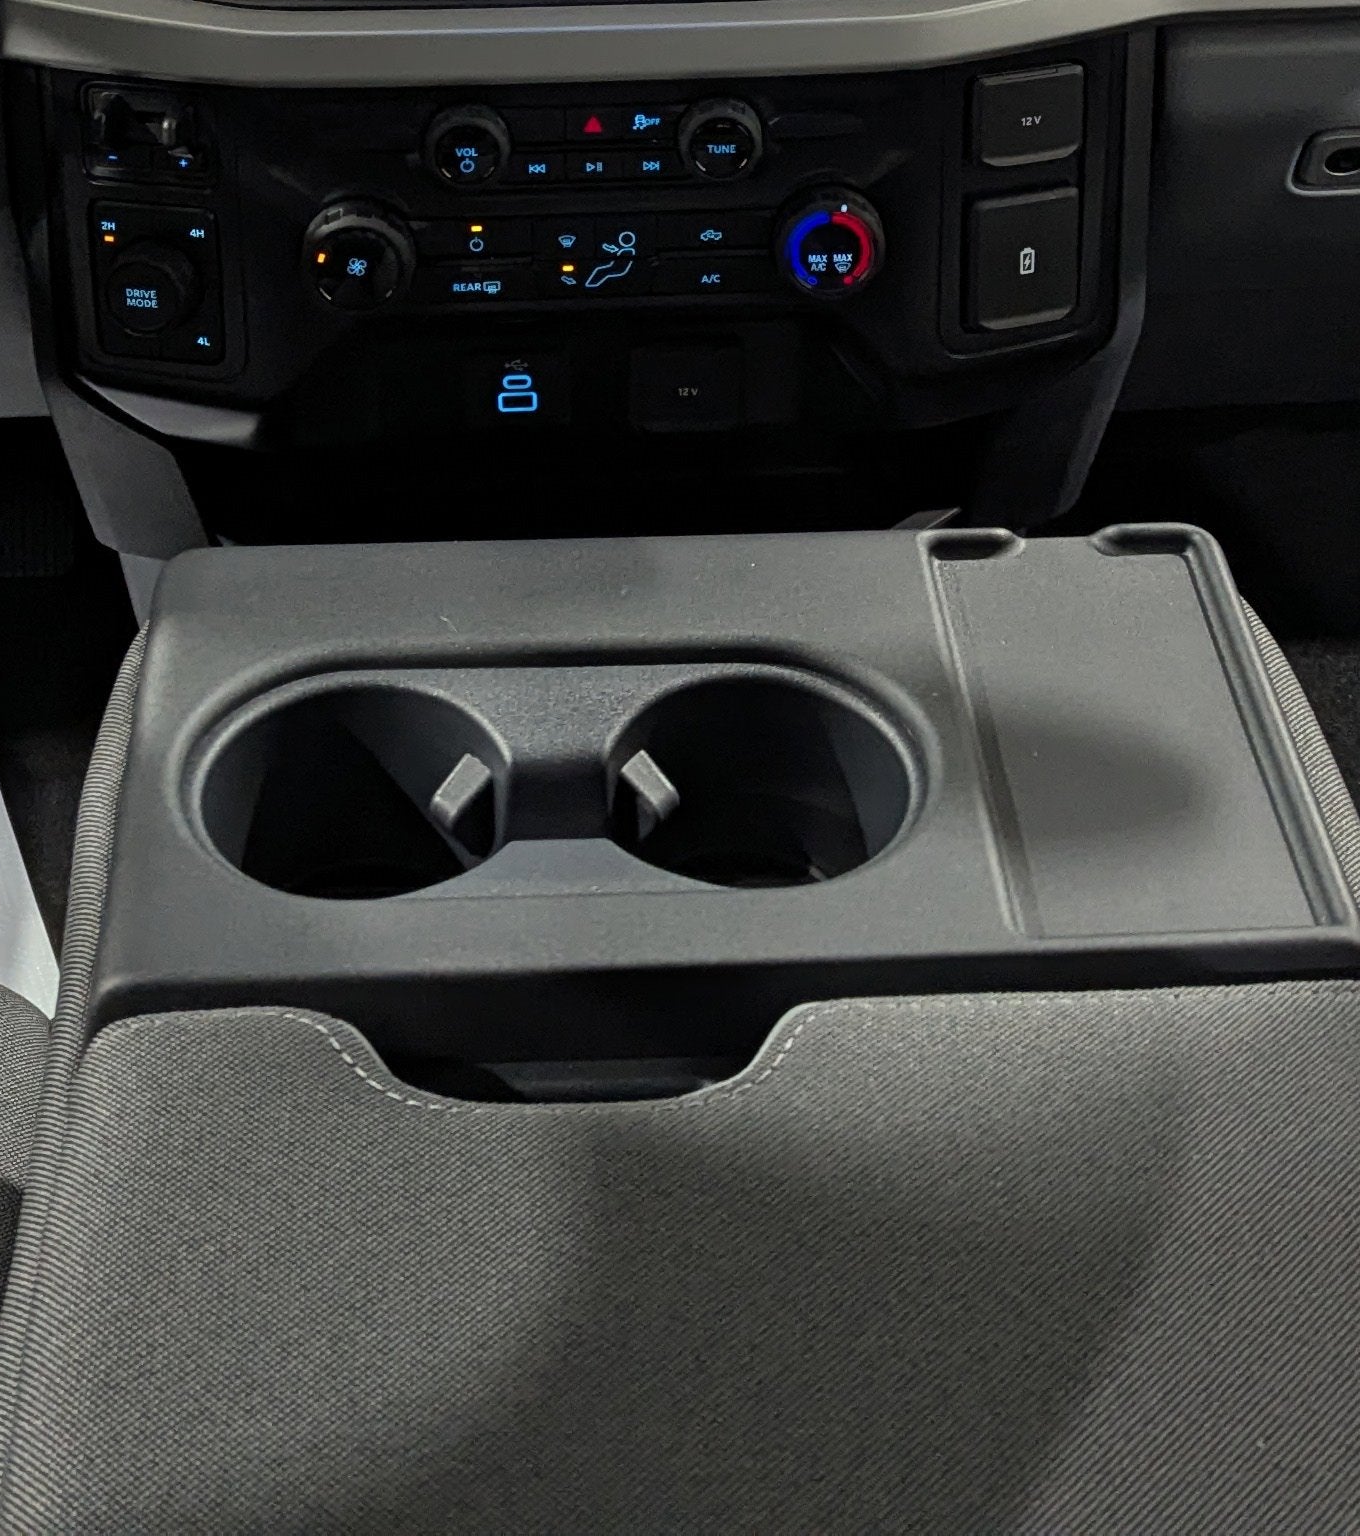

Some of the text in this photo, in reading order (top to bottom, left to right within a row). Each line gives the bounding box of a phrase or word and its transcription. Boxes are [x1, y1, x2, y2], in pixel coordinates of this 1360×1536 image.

[455, 147, 479, 158] VOL
[706, 144, 737, 154] TUNE
[189, 229, 205, 238] 4H
[808, 253, 828, 263] MAX
[833, 253, 853, 262] MAX
[810, 262, 827, 272] A/C
[700, 273, 721, 284] A/C
[452, 282, 482, 292] REAR
[125, 288, 158, 299] DRIVE
[126, 297, 159, 309] MODE
[196, 336, 211, 347] 4L
